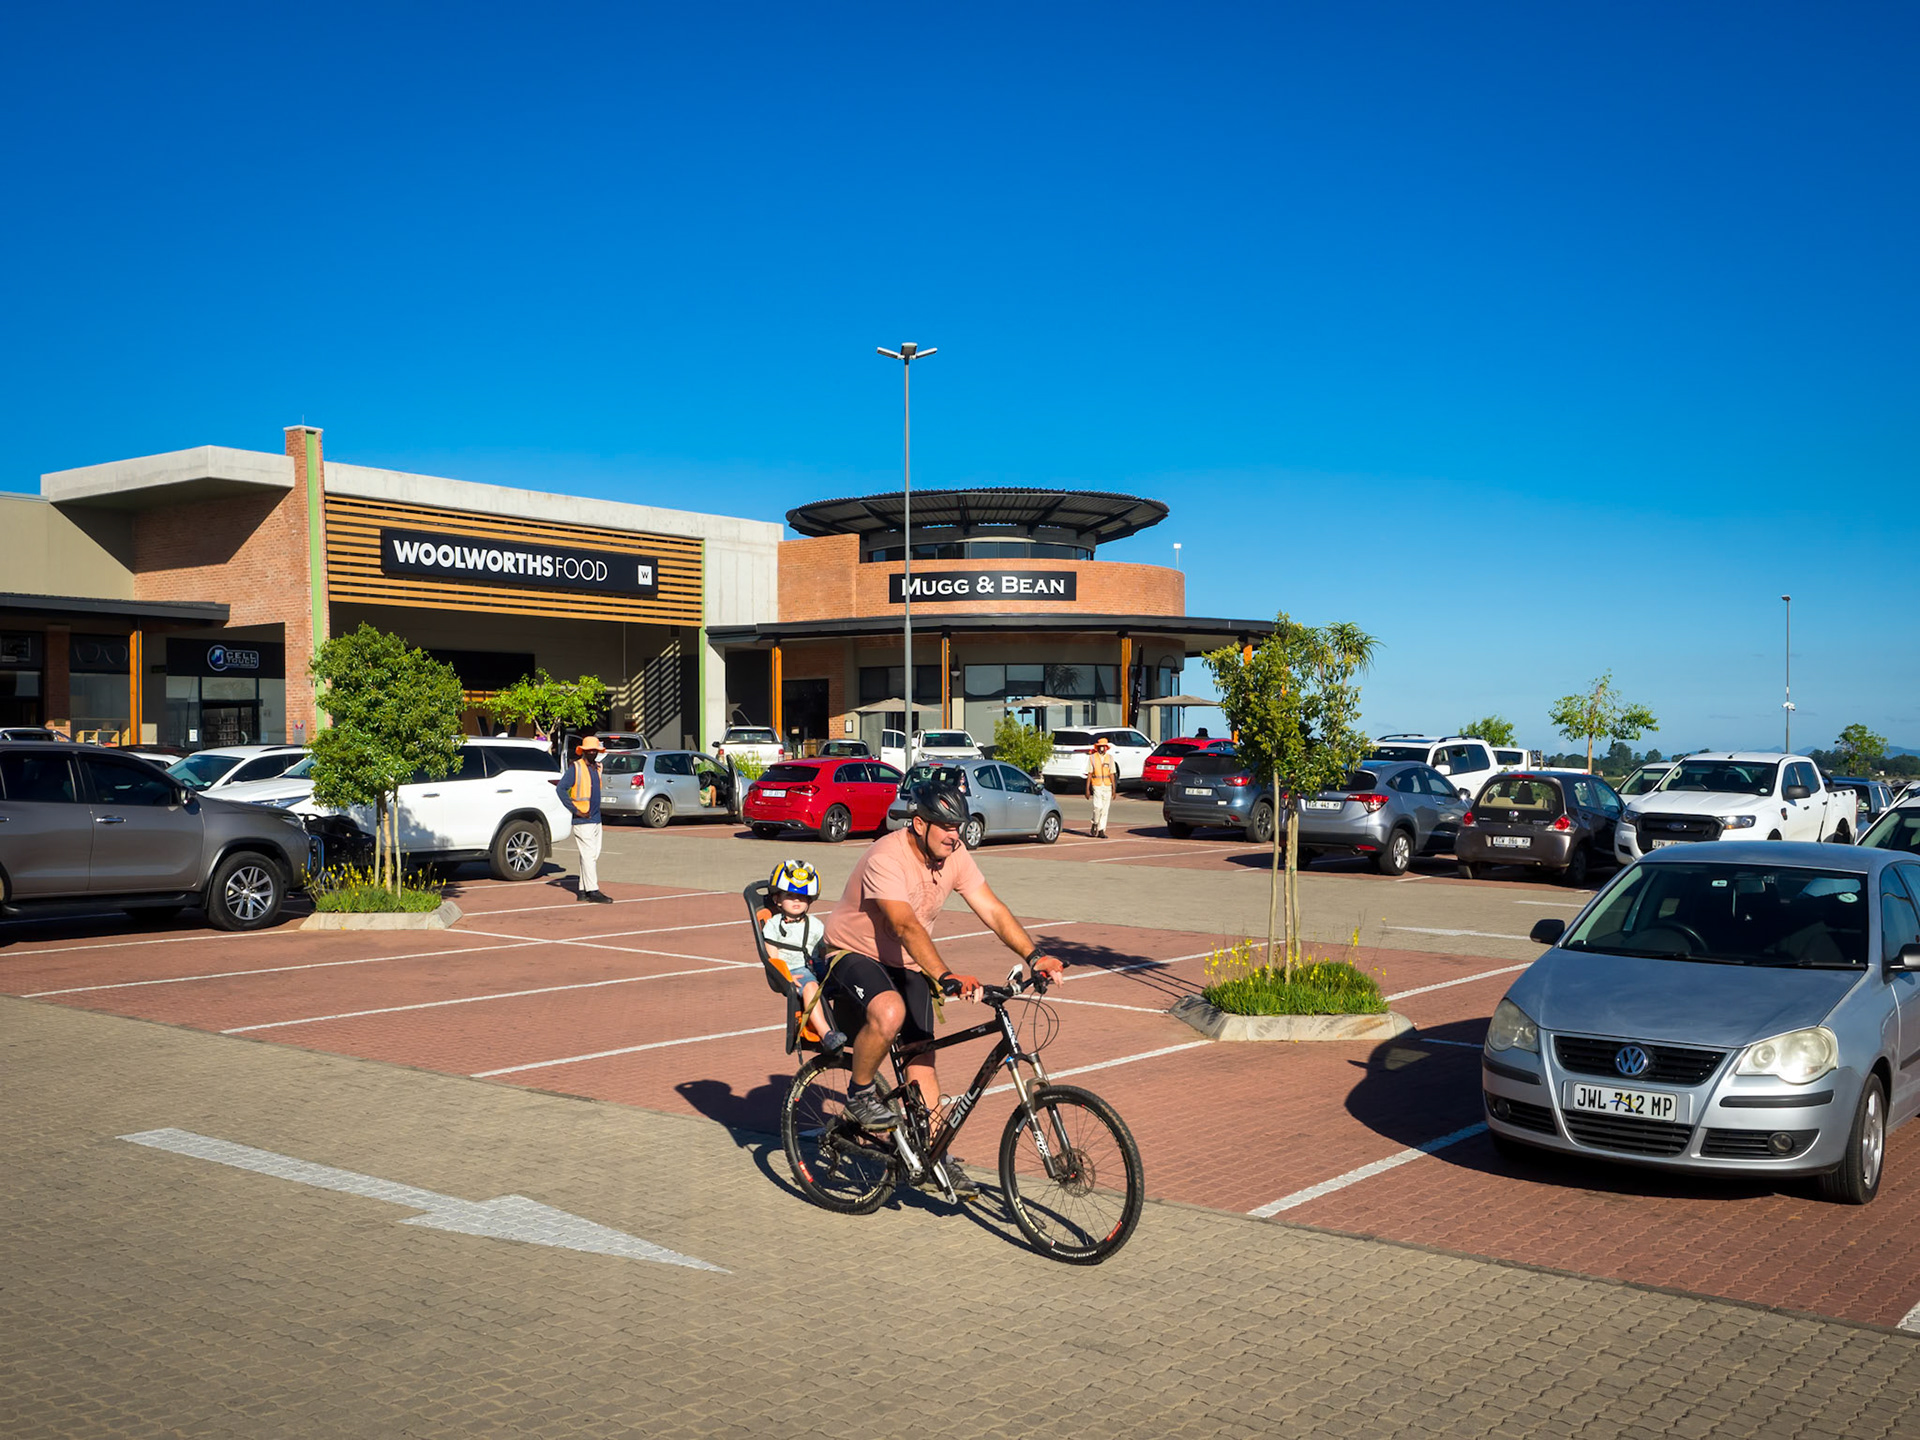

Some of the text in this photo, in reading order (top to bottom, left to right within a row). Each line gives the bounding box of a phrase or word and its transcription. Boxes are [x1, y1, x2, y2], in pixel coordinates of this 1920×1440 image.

[976, 575, 995, 594] &
[1001, 576, 1065, 594] BEAN
[226, 651, 256, 660] CELL
[950, 1087, 980, 1129] BMC
[1577, 1087, 1673, 1117] JWL 712 MP
